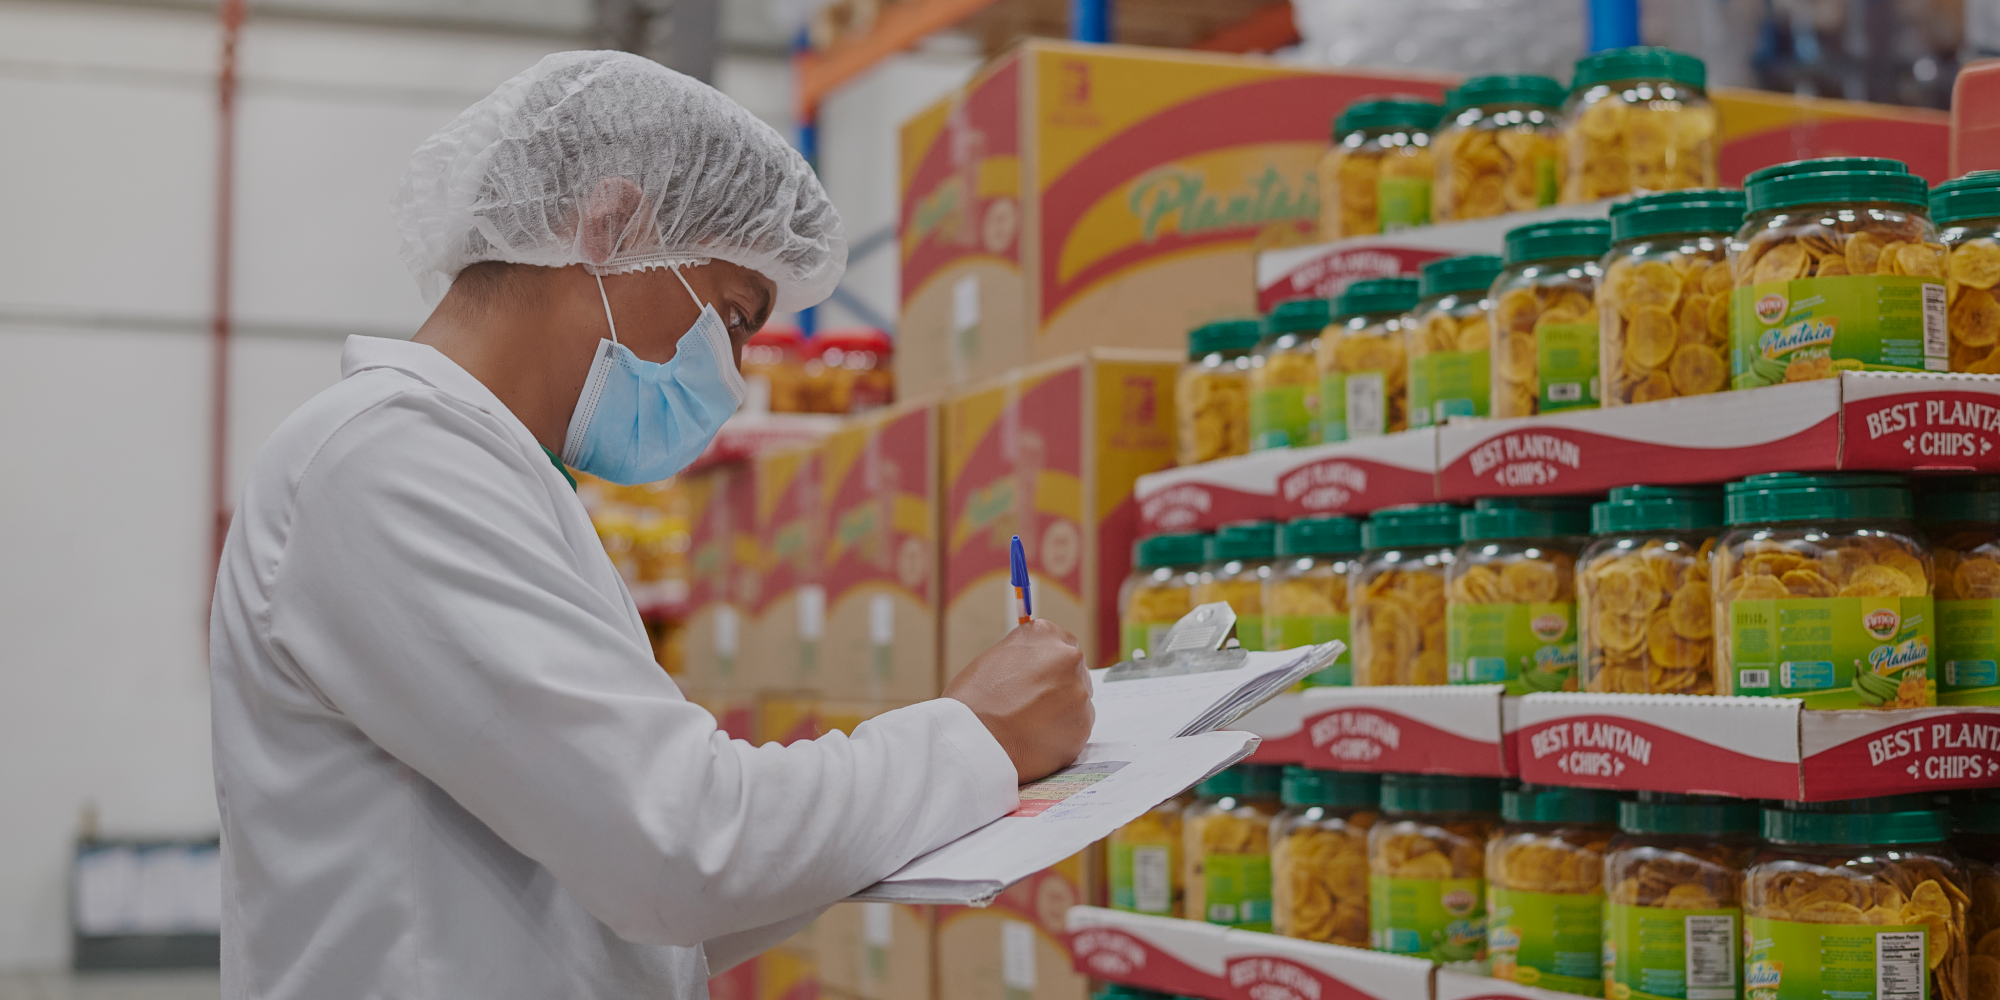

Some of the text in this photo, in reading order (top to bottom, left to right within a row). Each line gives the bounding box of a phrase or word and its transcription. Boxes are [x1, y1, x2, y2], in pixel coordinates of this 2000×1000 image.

[1130, 165, 1321, 242] Plantai
[1759, 321, 1834, 356] Plantain
[1866, 401, 1919, 440] BEST
[1469, 433, 1580, 477] BEST PLANTAIN
[1919, 431, 1975, 457] CHIPS
[1869, 640, 1928, 673] Plantain
[1531, 720, 1652, 767] BEST PLANTAIN
[1867, 722, 2000, 767] BEST PLANT
[1569, 750, 1613, 778] CHIPS
[1924, 754, 1983, 780] CHIPS
